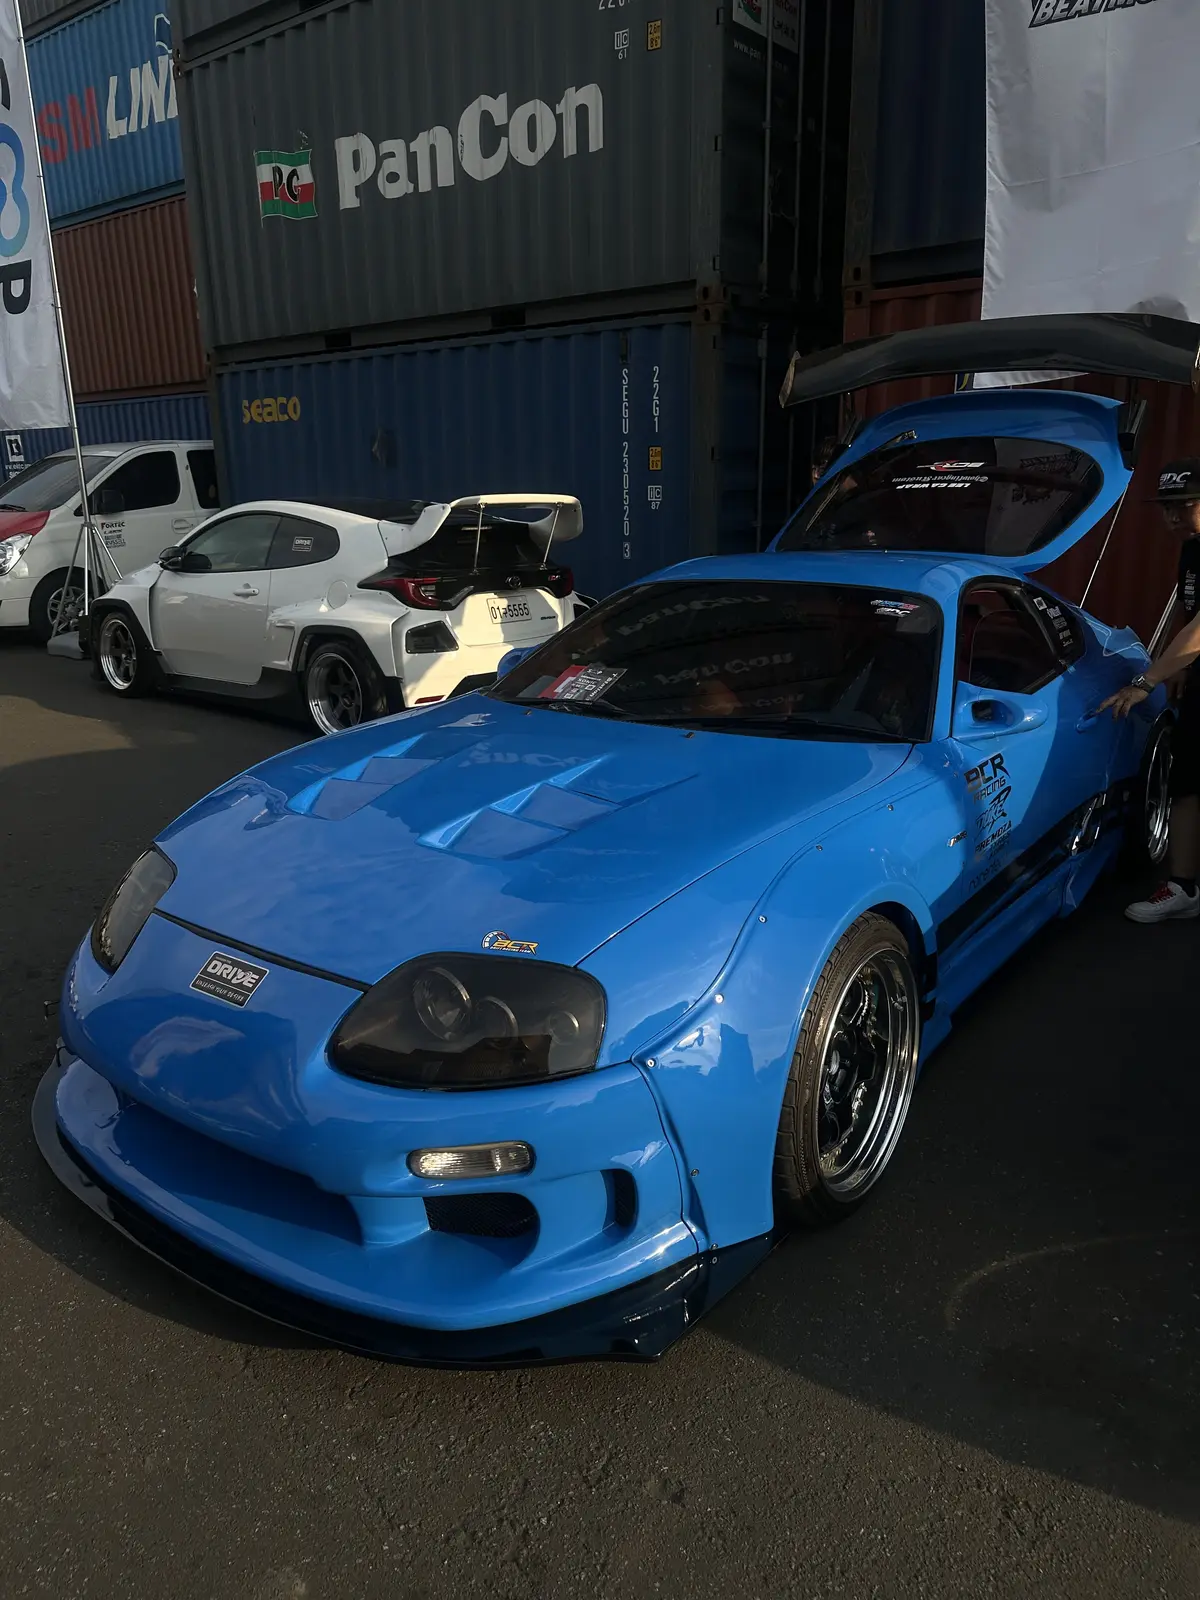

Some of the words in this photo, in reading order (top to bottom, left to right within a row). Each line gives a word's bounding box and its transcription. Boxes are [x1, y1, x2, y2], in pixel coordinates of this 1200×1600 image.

[618, 49, 627, 60] 61
[37, 87, 101, 164] SM
[335, 83, 604, 210] PanCon
[651, 502, 660, 510] 87
[623, 543, 630, 559] 3
[964, 753, 1011, 793] BCR
[973, 776, 1006, 804] RACING
[493, 939, 538, 955] BCR
[206, 960, 260, 988] DRIVE
